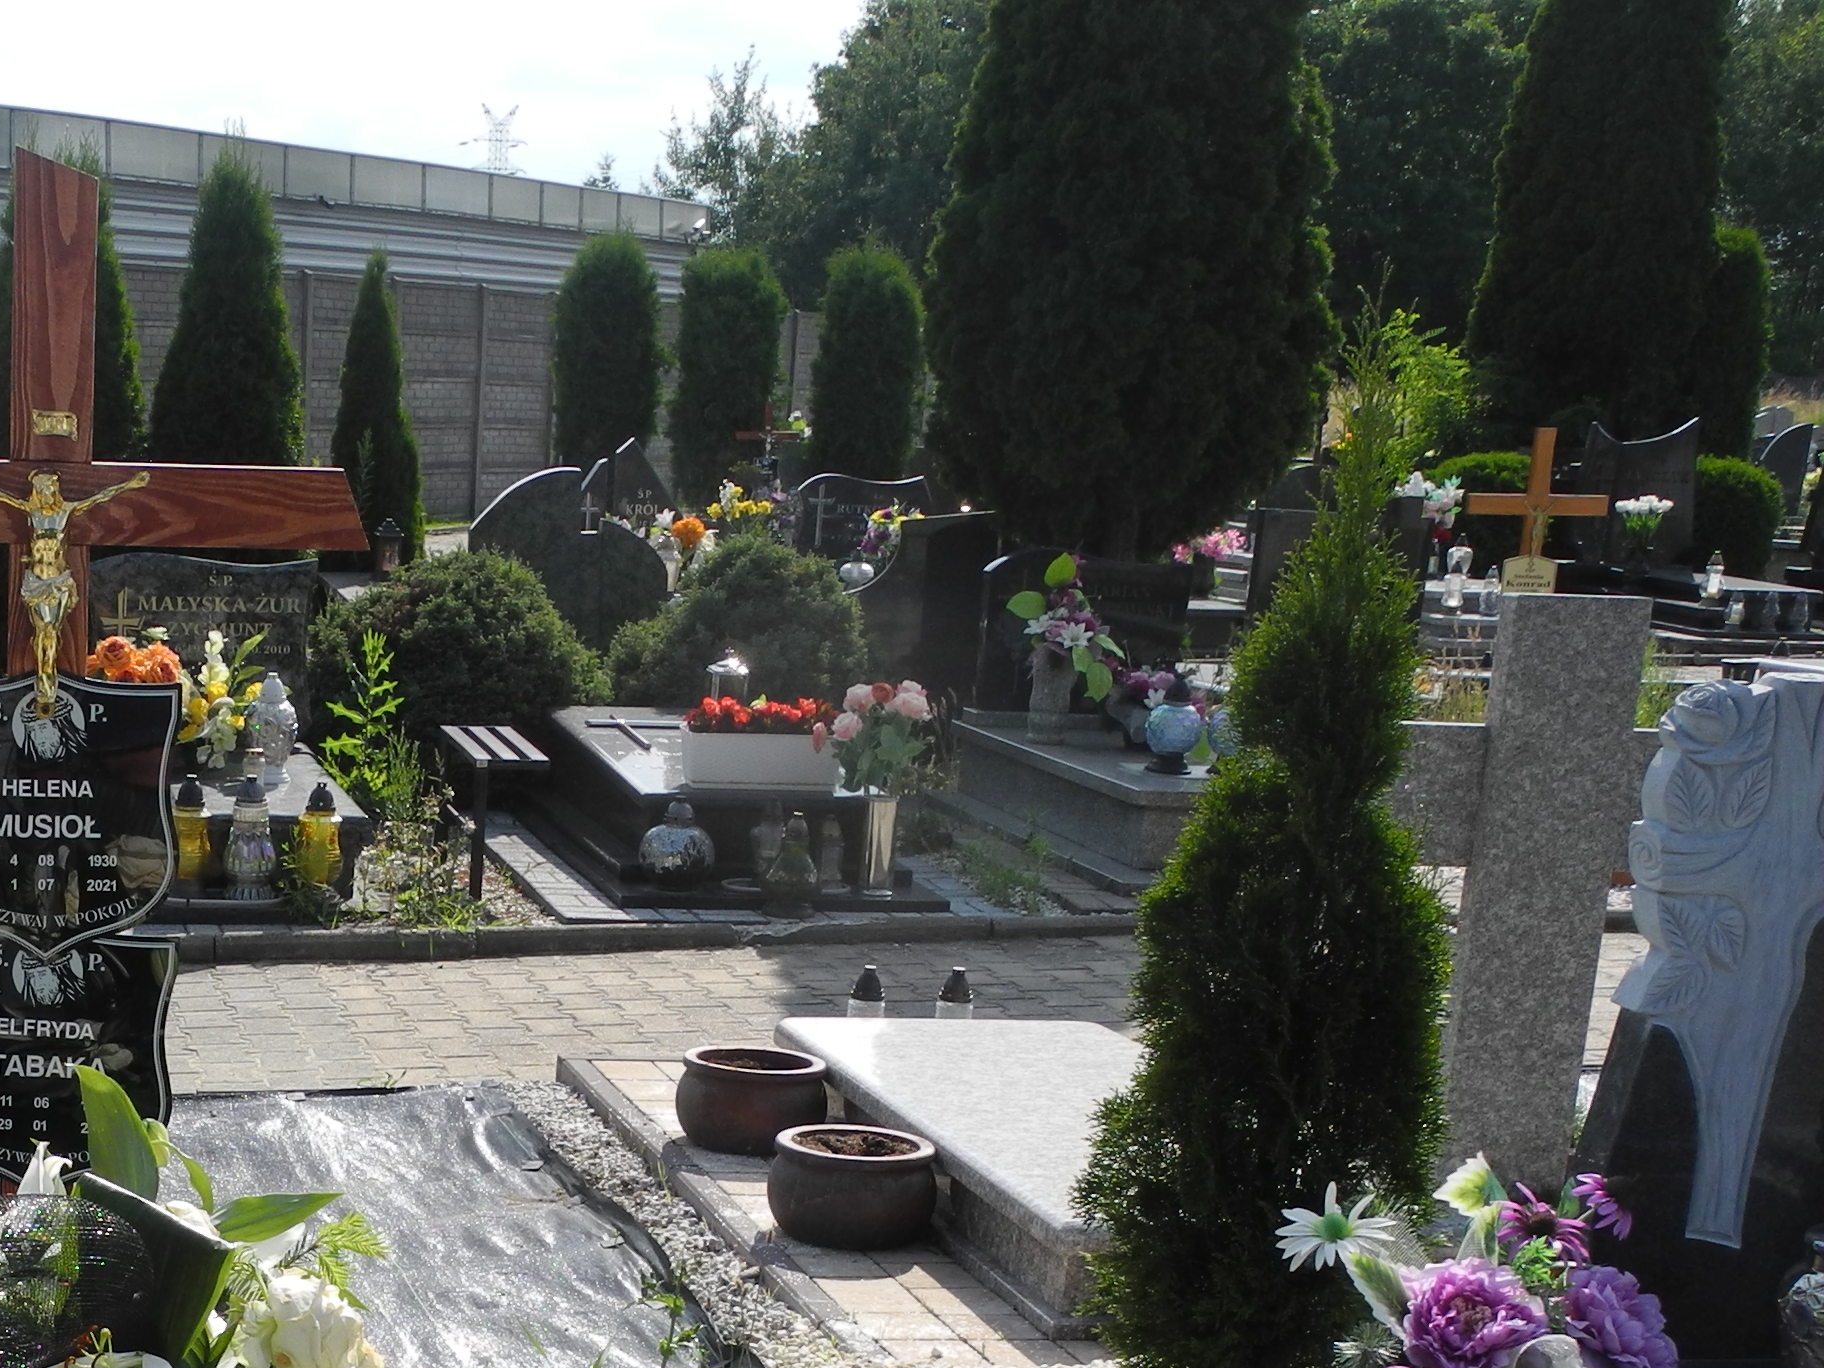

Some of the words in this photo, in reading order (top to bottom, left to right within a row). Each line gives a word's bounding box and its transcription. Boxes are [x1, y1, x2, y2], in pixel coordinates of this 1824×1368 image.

[1506, 580, 1551, 588] Konrad
[138, 592, 302, 614] MAŁYSKA-ŻUR
[89, 703, 108, 722] P.
[2, 779, 94, 798] HELENA
[9, 854, 19, 866] 4
[38, 854, 55, 867] 08
[87, 854, 117, 867] 1930
[10, 878, 18, 890] 1
[37, 878, 55, 891] 07
[86, 878, 117, 892] 2021
[53, 914, 68, 928] W
[75, 895, 139, 925] POKOJU
[87, 953, 106, 972] P.
[0, 1095, 13, 1107] 11
[33, 1096, 50, 1109] 06
[32, 1119, 48, 1132] 01
